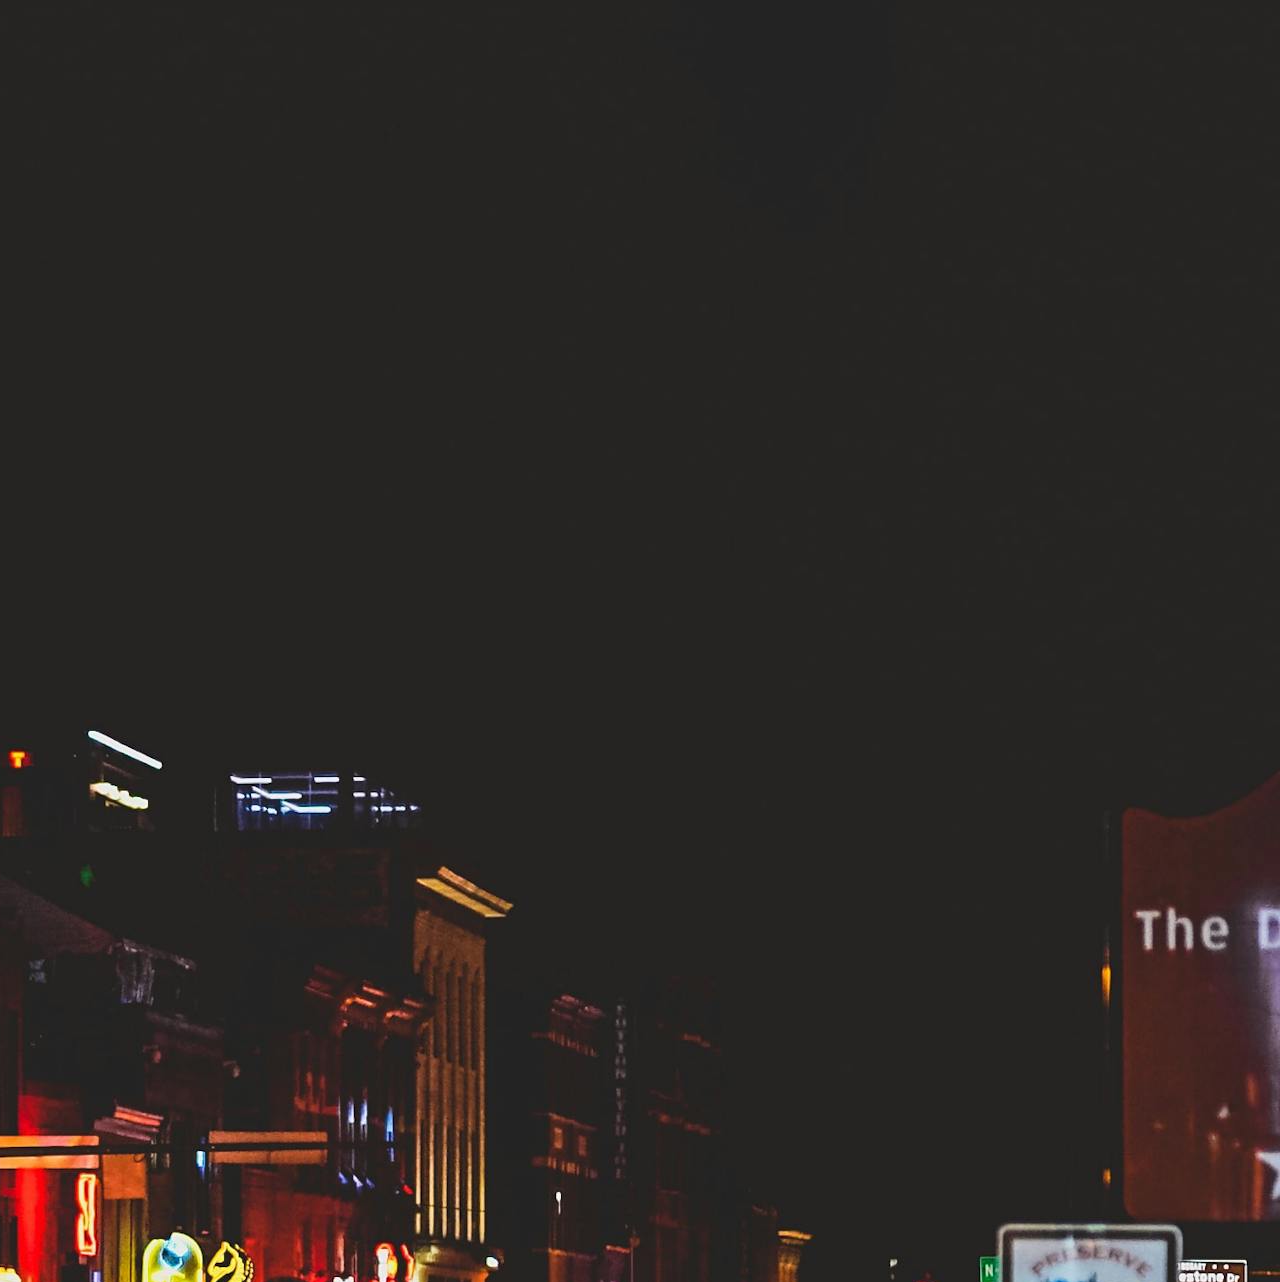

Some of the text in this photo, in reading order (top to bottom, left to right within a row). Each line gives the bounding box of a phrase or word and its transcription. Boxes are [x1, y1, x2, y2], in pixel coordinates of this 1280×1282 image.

[1134, 907, 1280, 951] The D
[1179, 1270, 1224, 1282] estone
